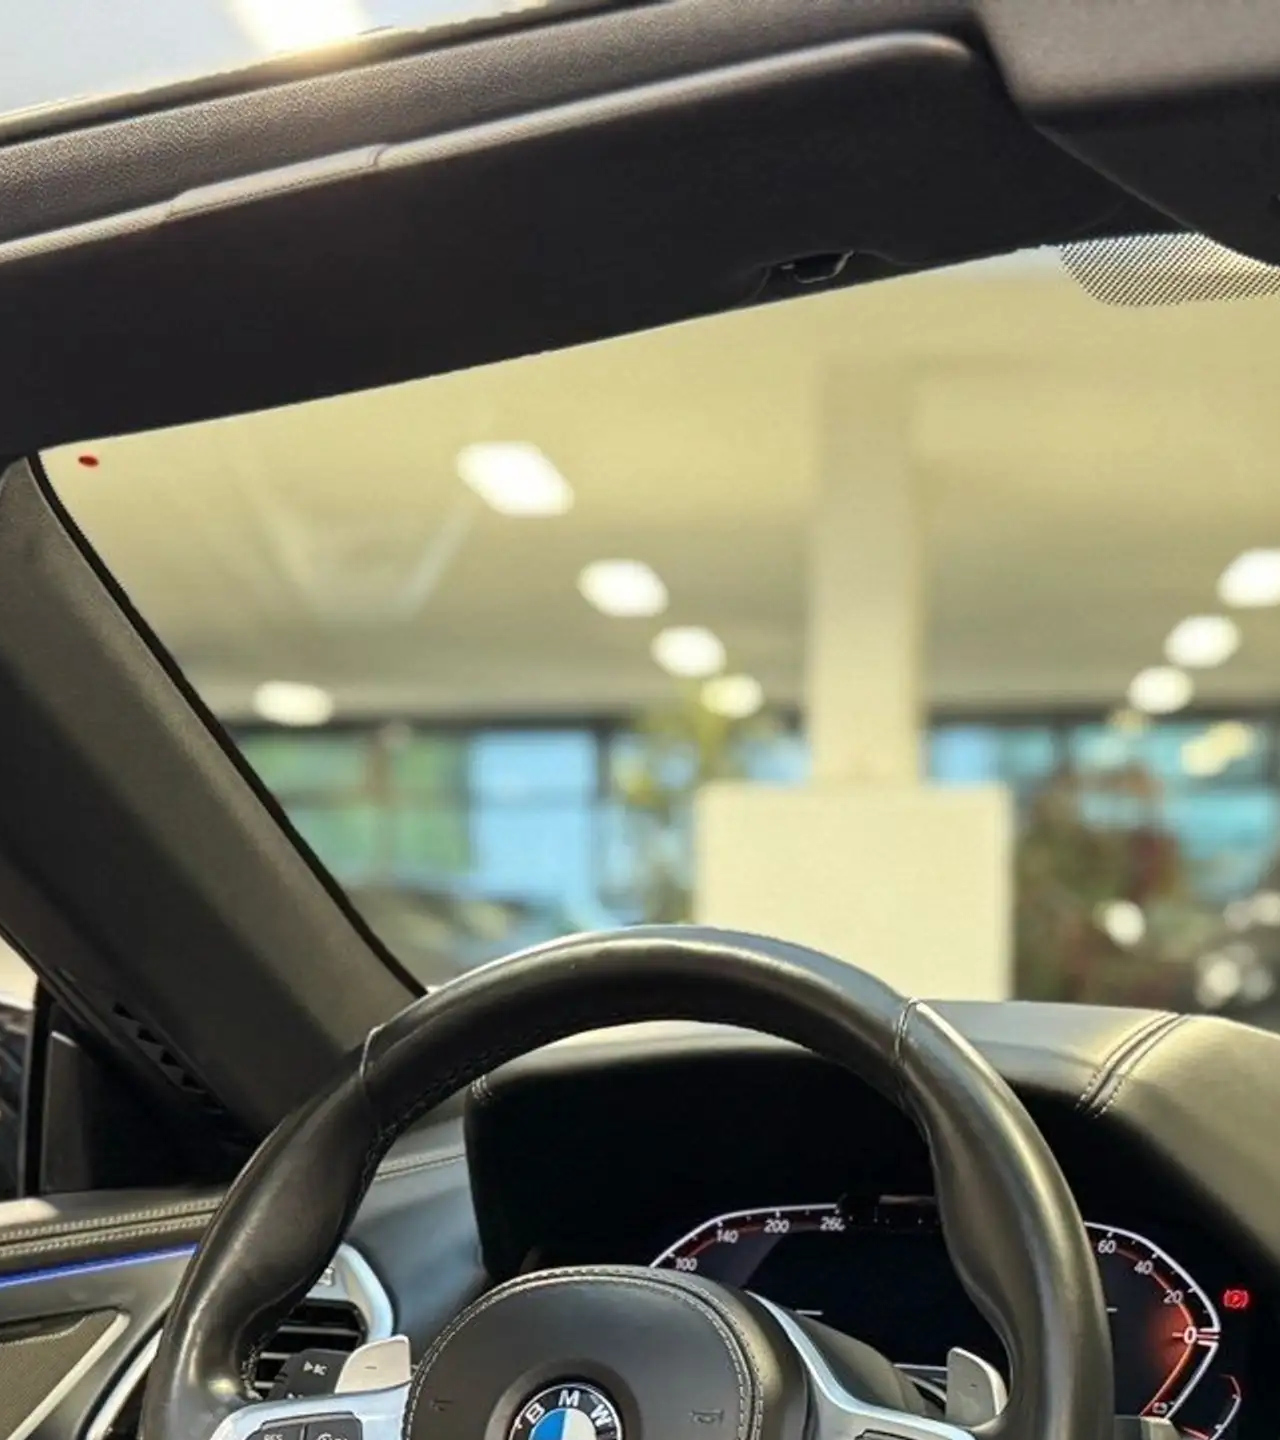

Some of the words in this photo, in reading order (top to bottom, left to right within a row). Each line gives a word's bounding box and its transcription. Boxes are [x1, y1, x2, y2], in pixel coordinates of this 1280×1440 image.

[764, 1219, 790, 1234] 200
[716, 1229, 739, 1244] 140
[1097, 1239, 1117, 1254] 60
[674, 1257, 698, 1272] 100
[1134, 1261, 1154, 1275] 40
[1163, 1289, 1184, 1304] 20
[1183, 1325, 1197, 1344] 0
[525, 1388, 614, 1430] BMW
